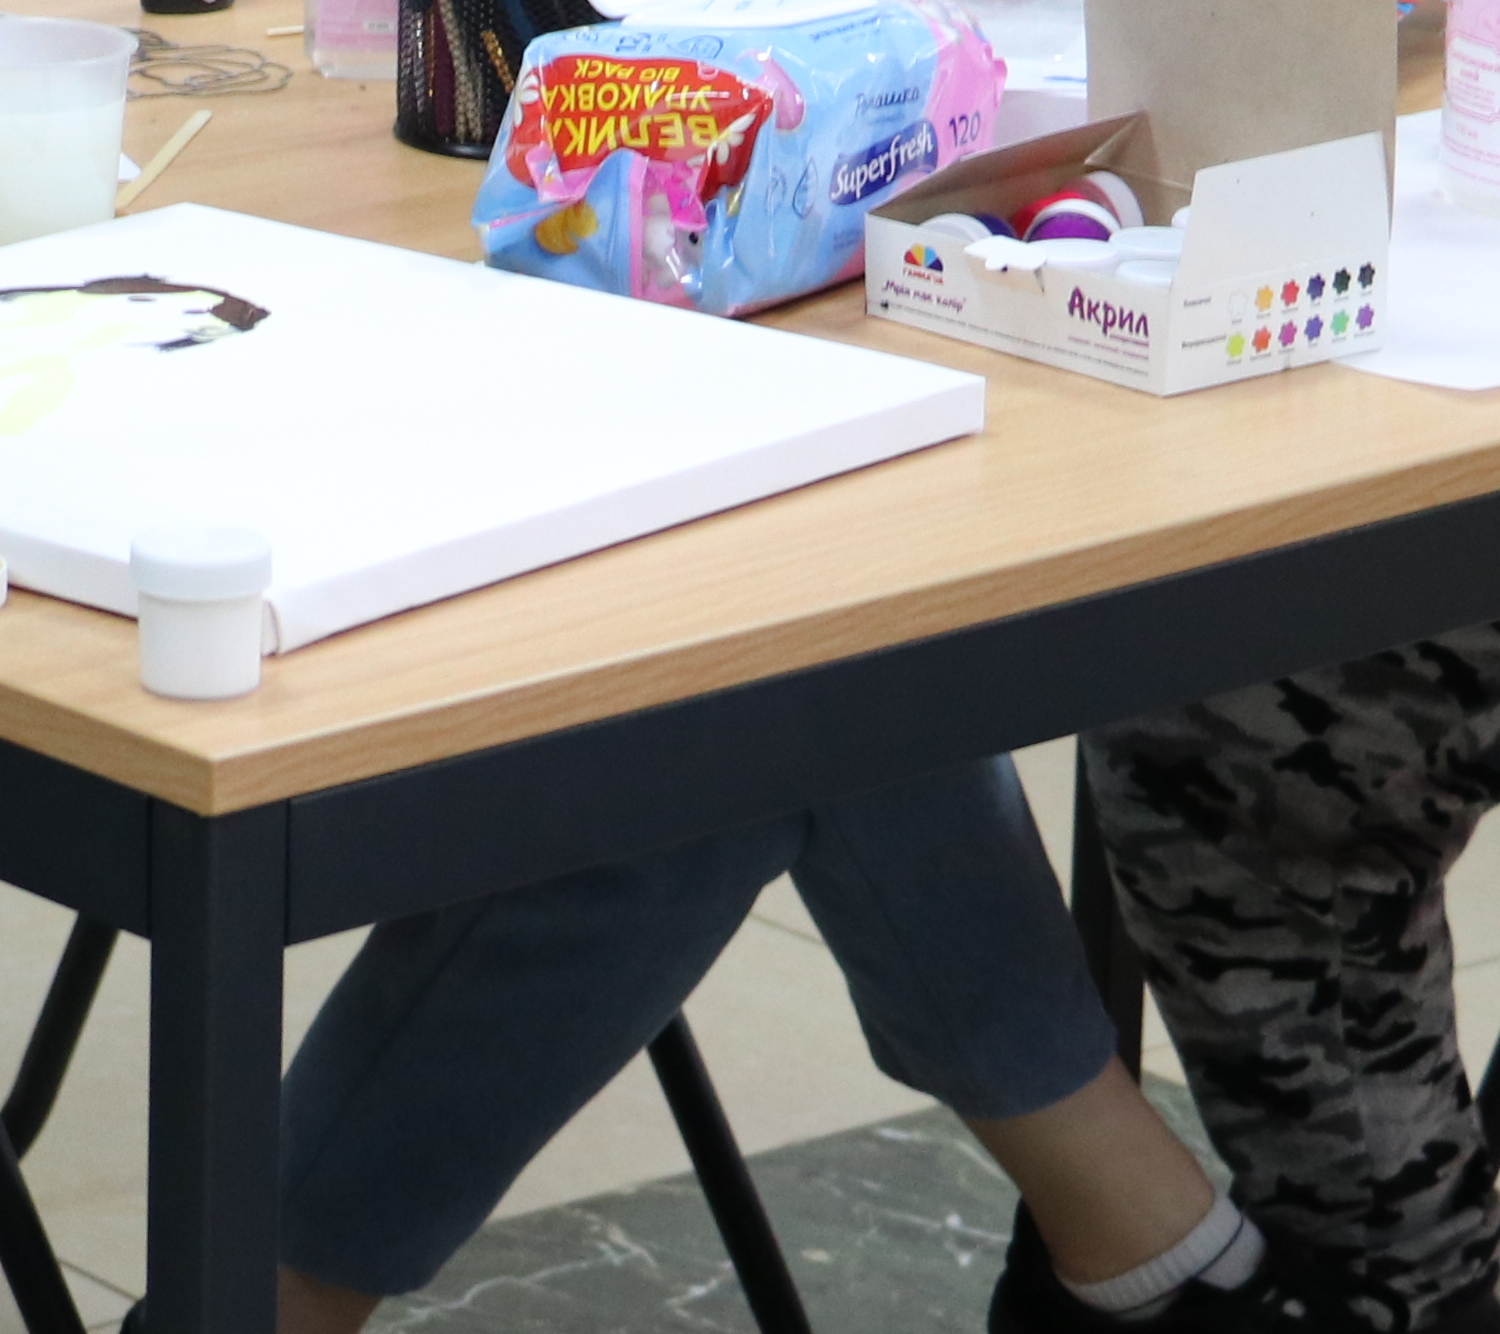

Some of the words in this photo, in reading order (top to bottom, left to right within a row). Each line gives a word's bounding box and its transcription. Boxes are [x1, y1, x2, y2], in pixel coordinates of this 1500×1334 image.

[573, 57, 635, 79] PACK
[639, 66, 682, 83] BIG
[540, 81, 713, 112] УПАКОВКА
[949, 111, 981, 147] 120
[830, 122, 934, 199] Superfresh
[1067, 285, 1149, 337] Акрил
